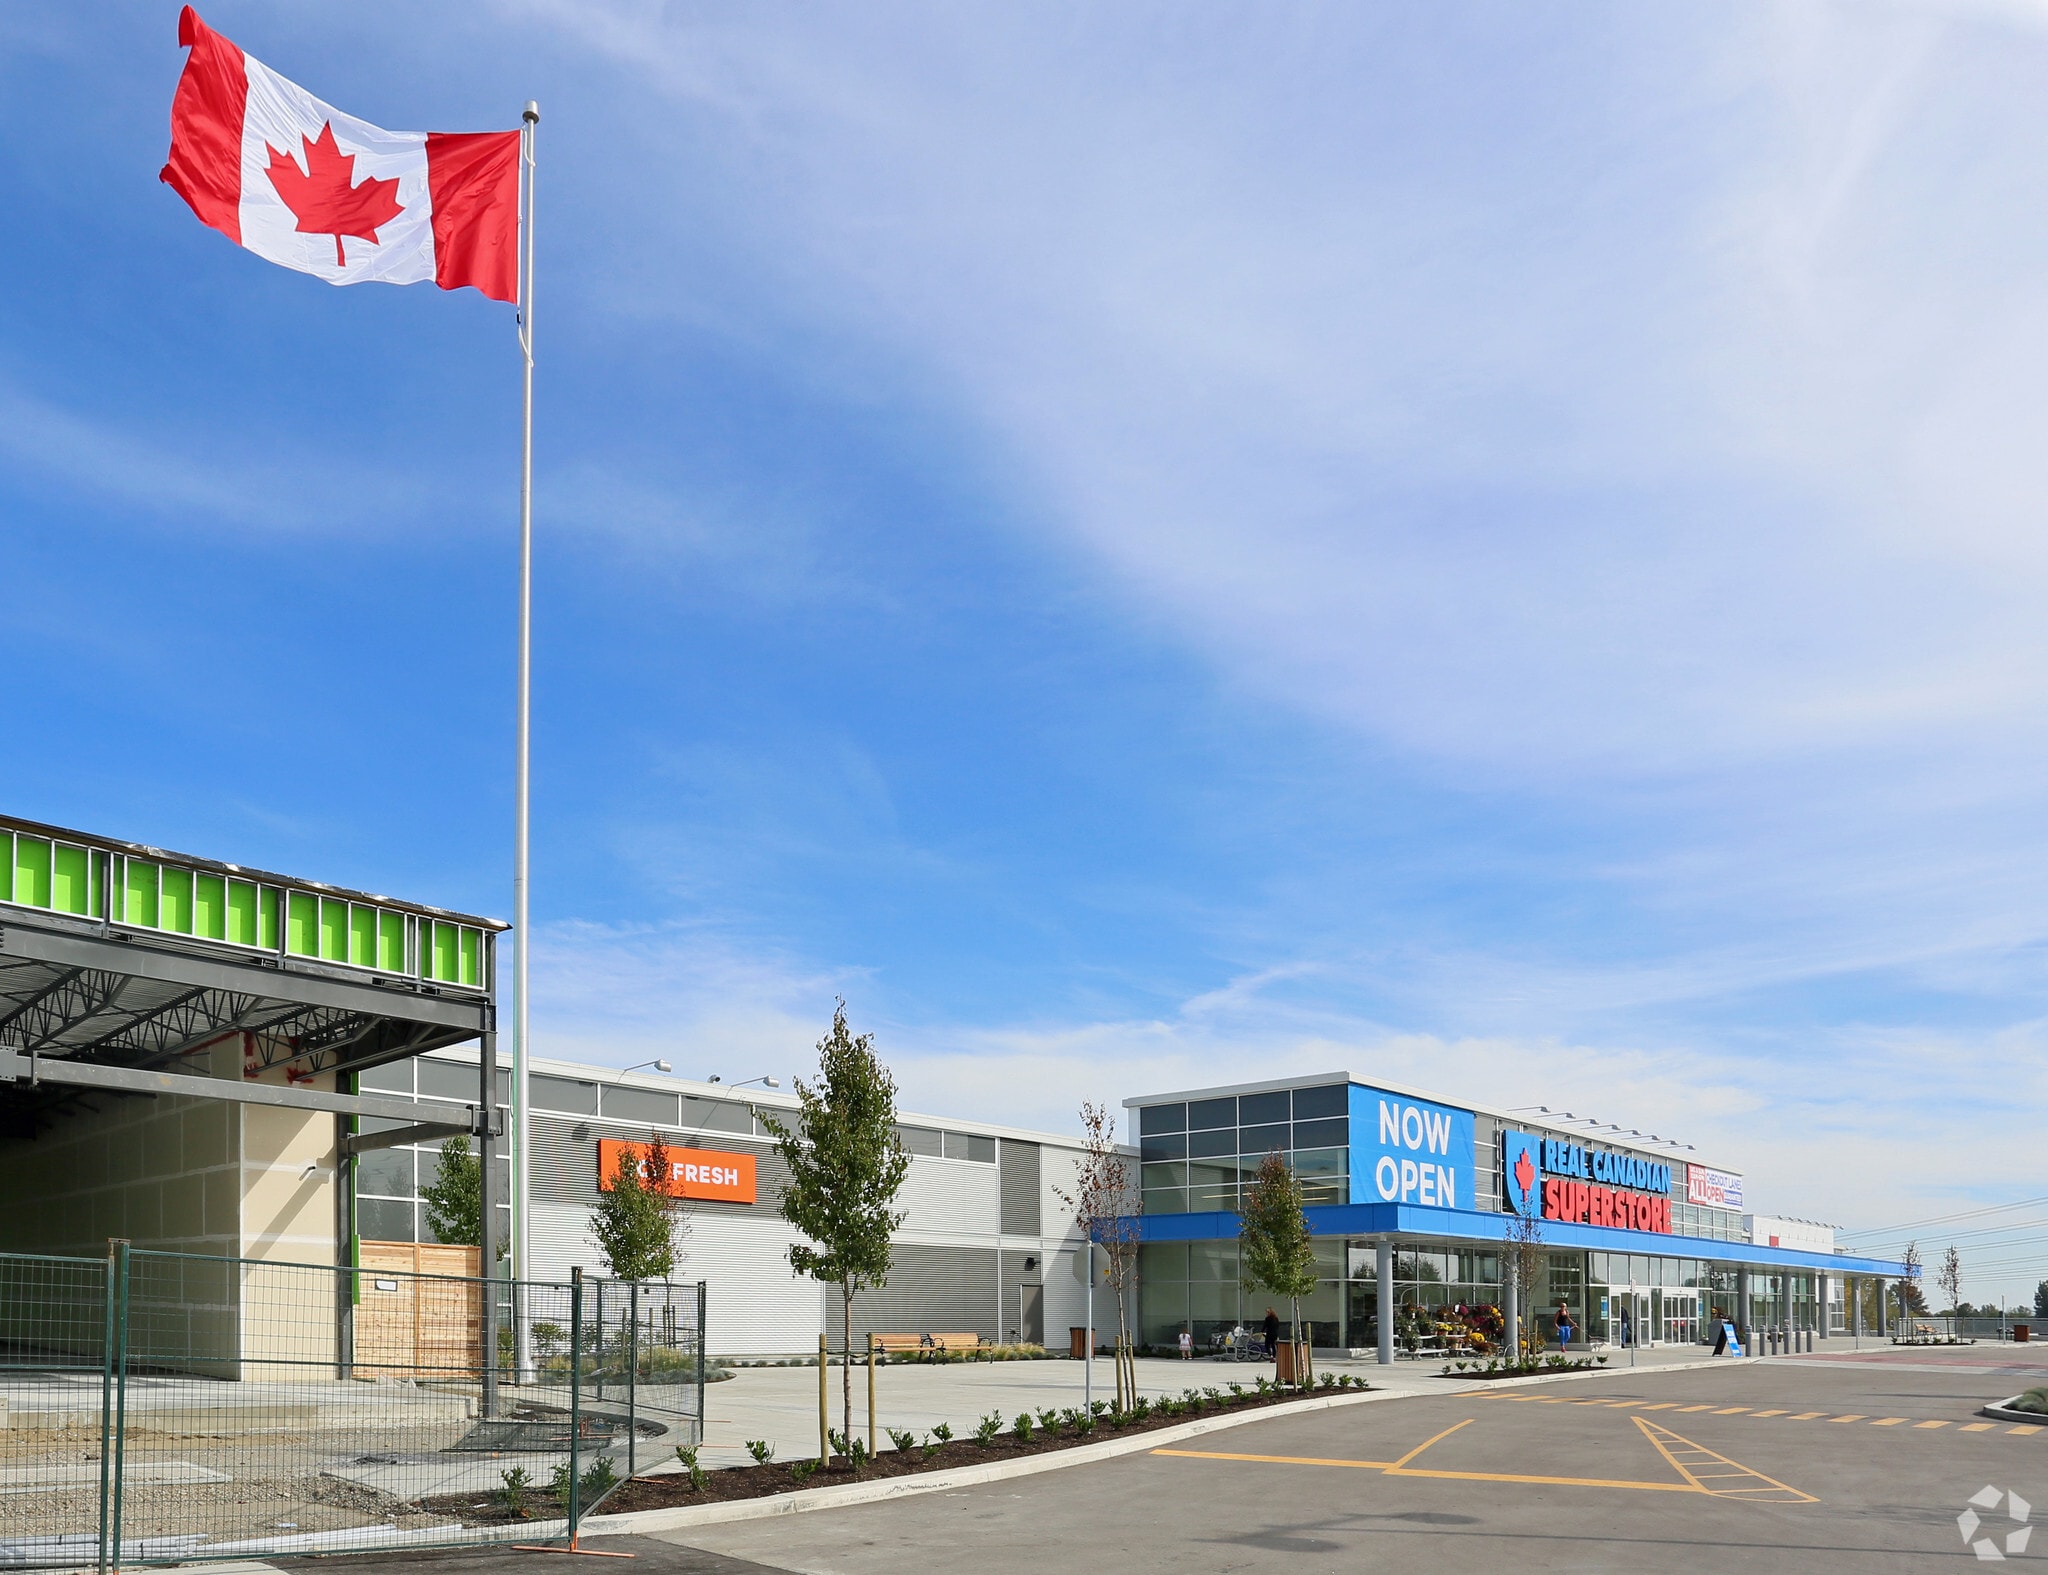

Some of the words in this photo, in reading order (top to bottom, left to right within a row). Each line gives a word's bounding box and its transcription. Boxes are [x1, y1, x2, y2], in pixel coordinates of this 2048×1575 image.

[1379, 1101, 1451, 1155] NOW
[672, 1162, 738, 1186] FRESH
[1376, 1156, 1454, 1208] OPEN
[1545, 1138, 1588, 1178] REAL
[1593, 1149, 1670, 1193] CANADIAN
[1688, 1179, 1707, 1201] ALL
[1707, 1185, 1725, 1203] OPEN
[1545, 1178, 1672, 1234] SUPERSTORE
